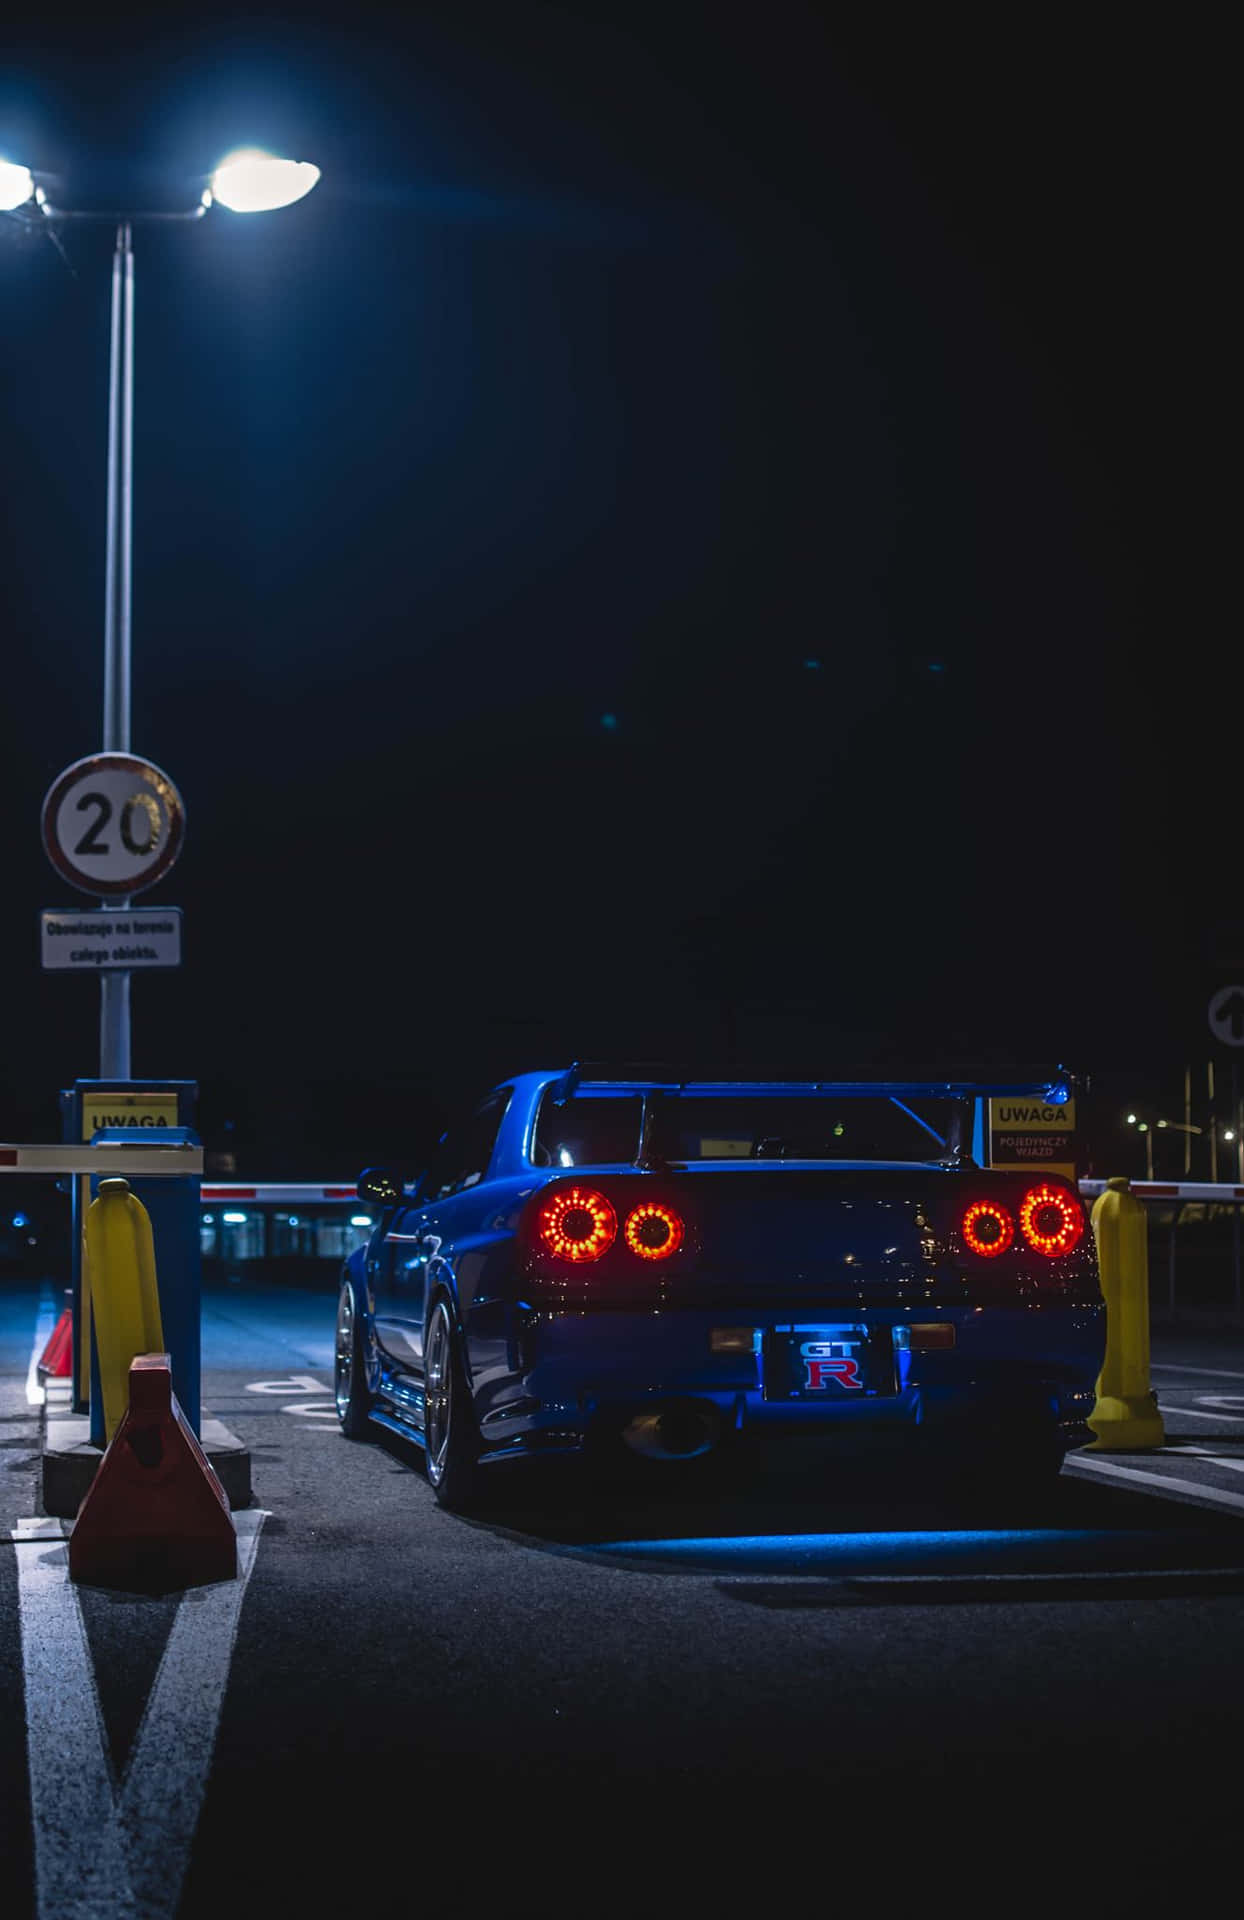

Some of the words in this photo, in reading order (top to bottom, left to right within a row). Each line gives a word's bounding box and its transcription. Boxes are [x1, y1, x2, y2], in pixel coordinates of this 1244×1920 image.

[74, 792, 161, 856] 20
[115, 922, 130, 934] na
[1000, 1107, 1067, 1121] UWAGA
[92, 1115, 167, 1128] UWAGA
[1000, 1136, 1067, 1147] POJEDYNCZY
[1016, 1147, 1054, 1156] WJAZD
[800, 1341, 861, 1357] GT
[803, 1357, 863, 1389] R
